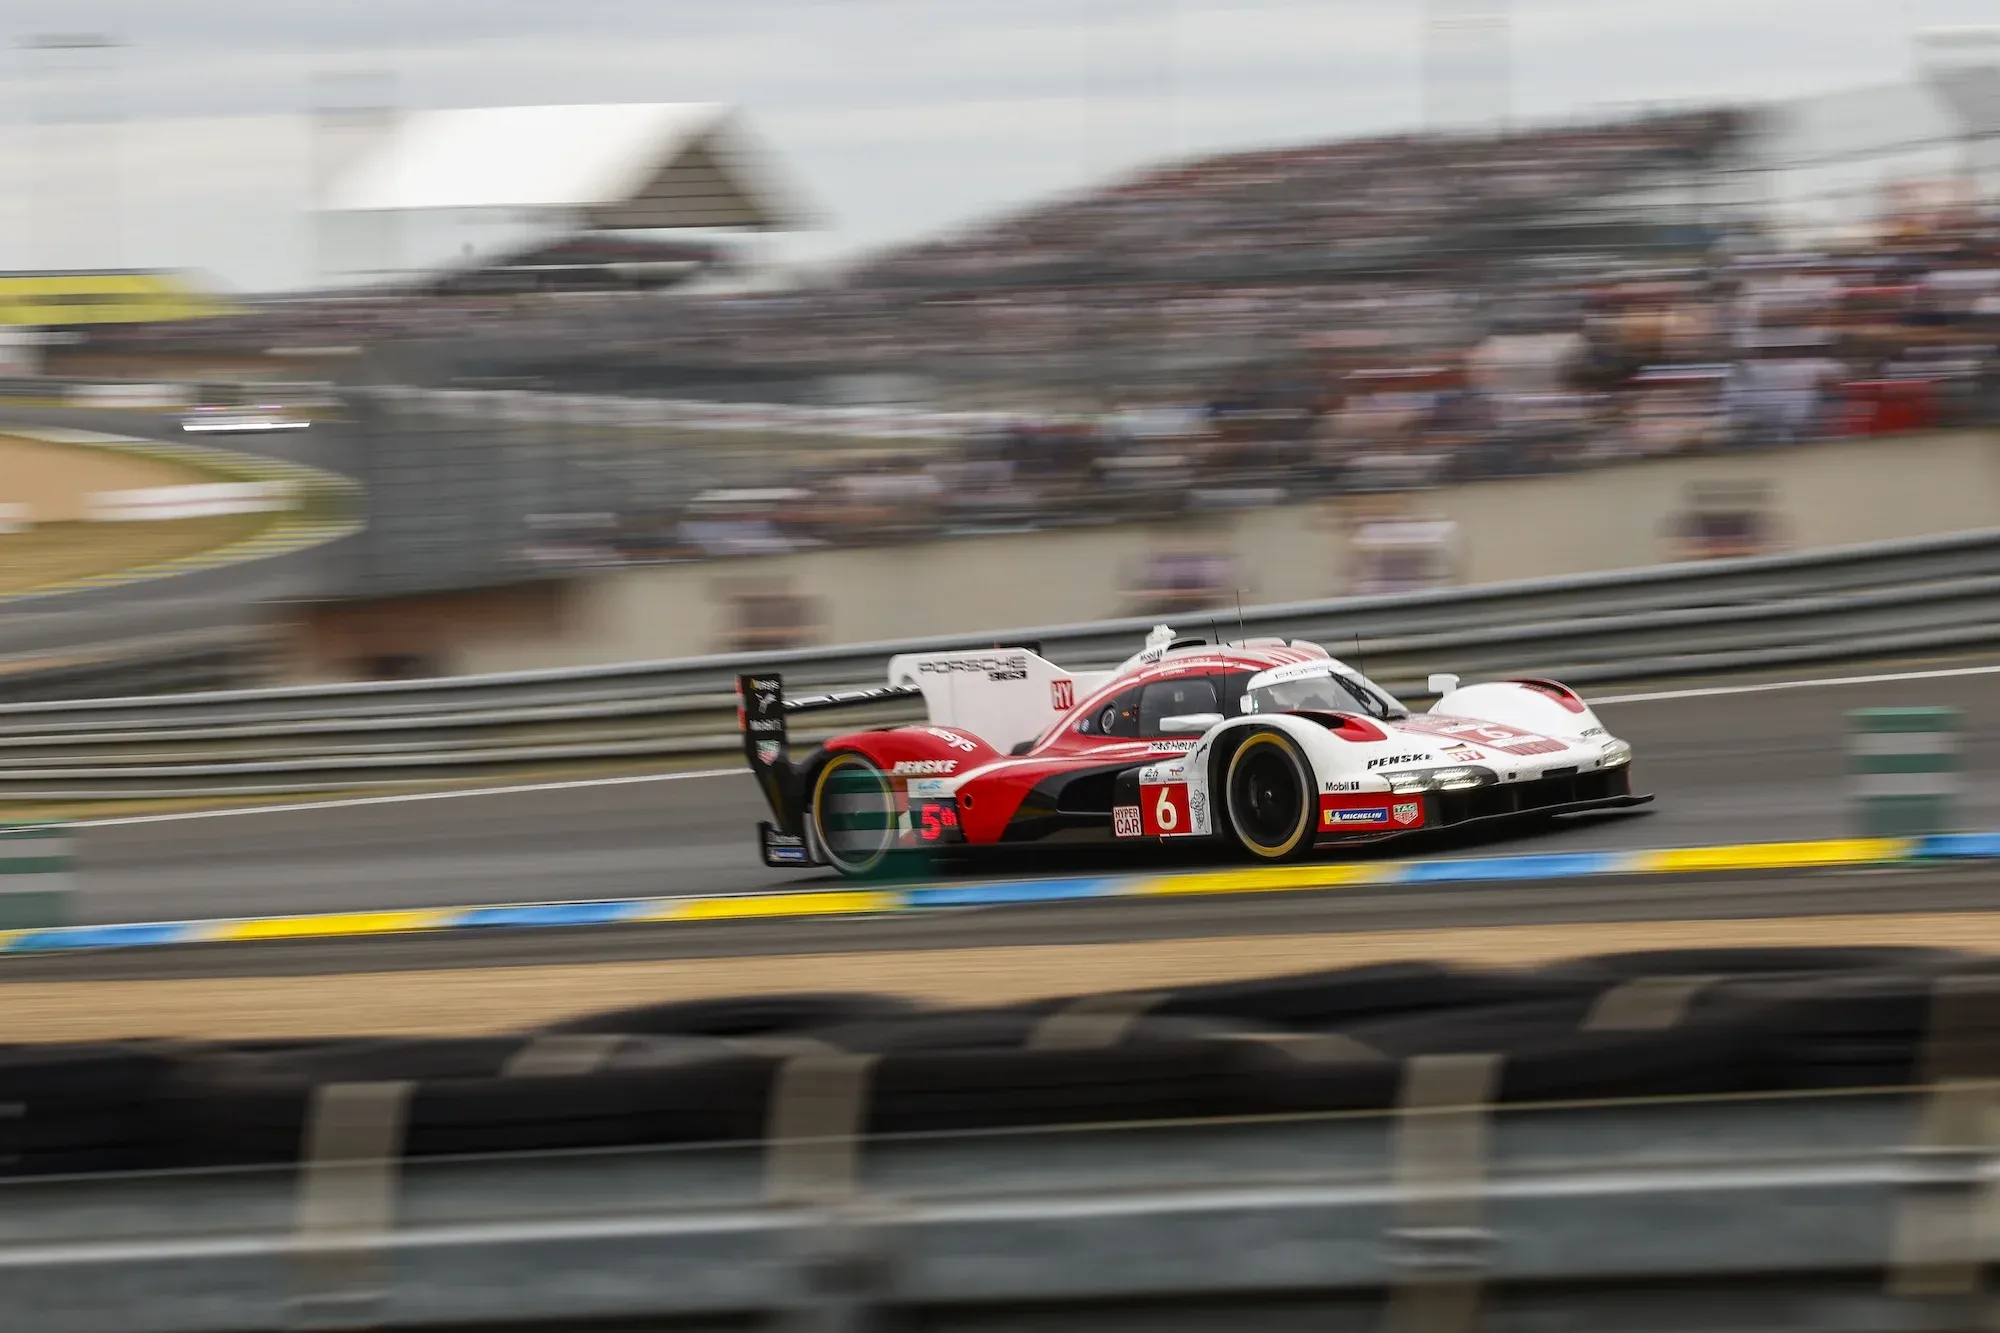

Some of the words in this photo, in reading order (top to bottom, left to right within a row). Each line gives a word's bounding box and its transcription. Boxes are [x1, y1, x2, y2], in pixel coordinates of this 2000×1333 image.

[918, 657, 1027, 674] PORSCHE
[1053, 681, 1073, 710] HY
[1477, 728, 1514, 739] 6
[892, 760, 958, 774] PENSKE
[1367, 753, 1433, 770] PENSKE
[1325, 782, 1350, 791] Mobil
[1350, 781, 1360, 790] 1
[1115, 808, 1139, 819] HYPER
[1156, 787, 1177, 830] 6
[1342, 812, 1382, 820] MICHELIN
[1116, 819, 1140, 834] CAR
